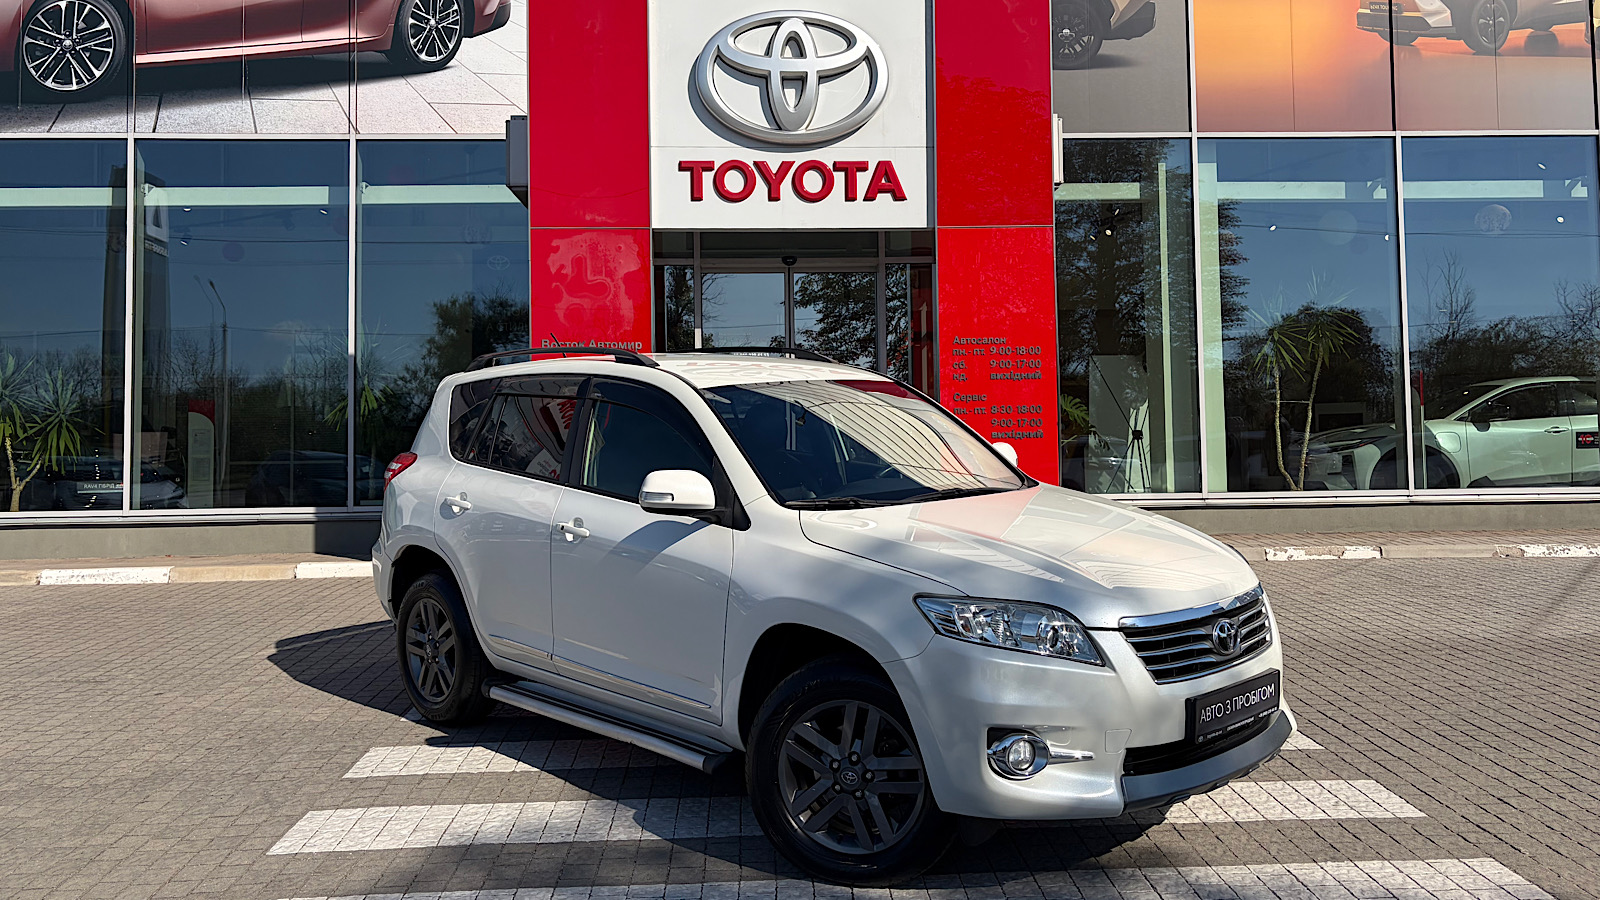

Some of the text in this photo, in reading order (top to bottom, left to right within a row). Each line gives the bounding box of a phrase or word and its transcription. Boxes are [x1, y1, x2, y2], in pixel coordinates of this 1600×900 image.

[678, 160, 907, 203] TOYOTA
[541, 338, 643, 350] Восток Автомир
[952, 335, 1007, 345] Автосалон
[952, 359, 1042, 370] сб. 9:00-17:00
[990, 370, 1042, 381] вихідний
[953, 392, 987, 403] Сервіс
[990, 418, 1043, 428] 9:00-17:00
[991, 429, 1044, 440] вихідний
[1199, 702, 1224, 724] АВТО
[1232, 683, 1275, 712] ПРОБІГОМ
